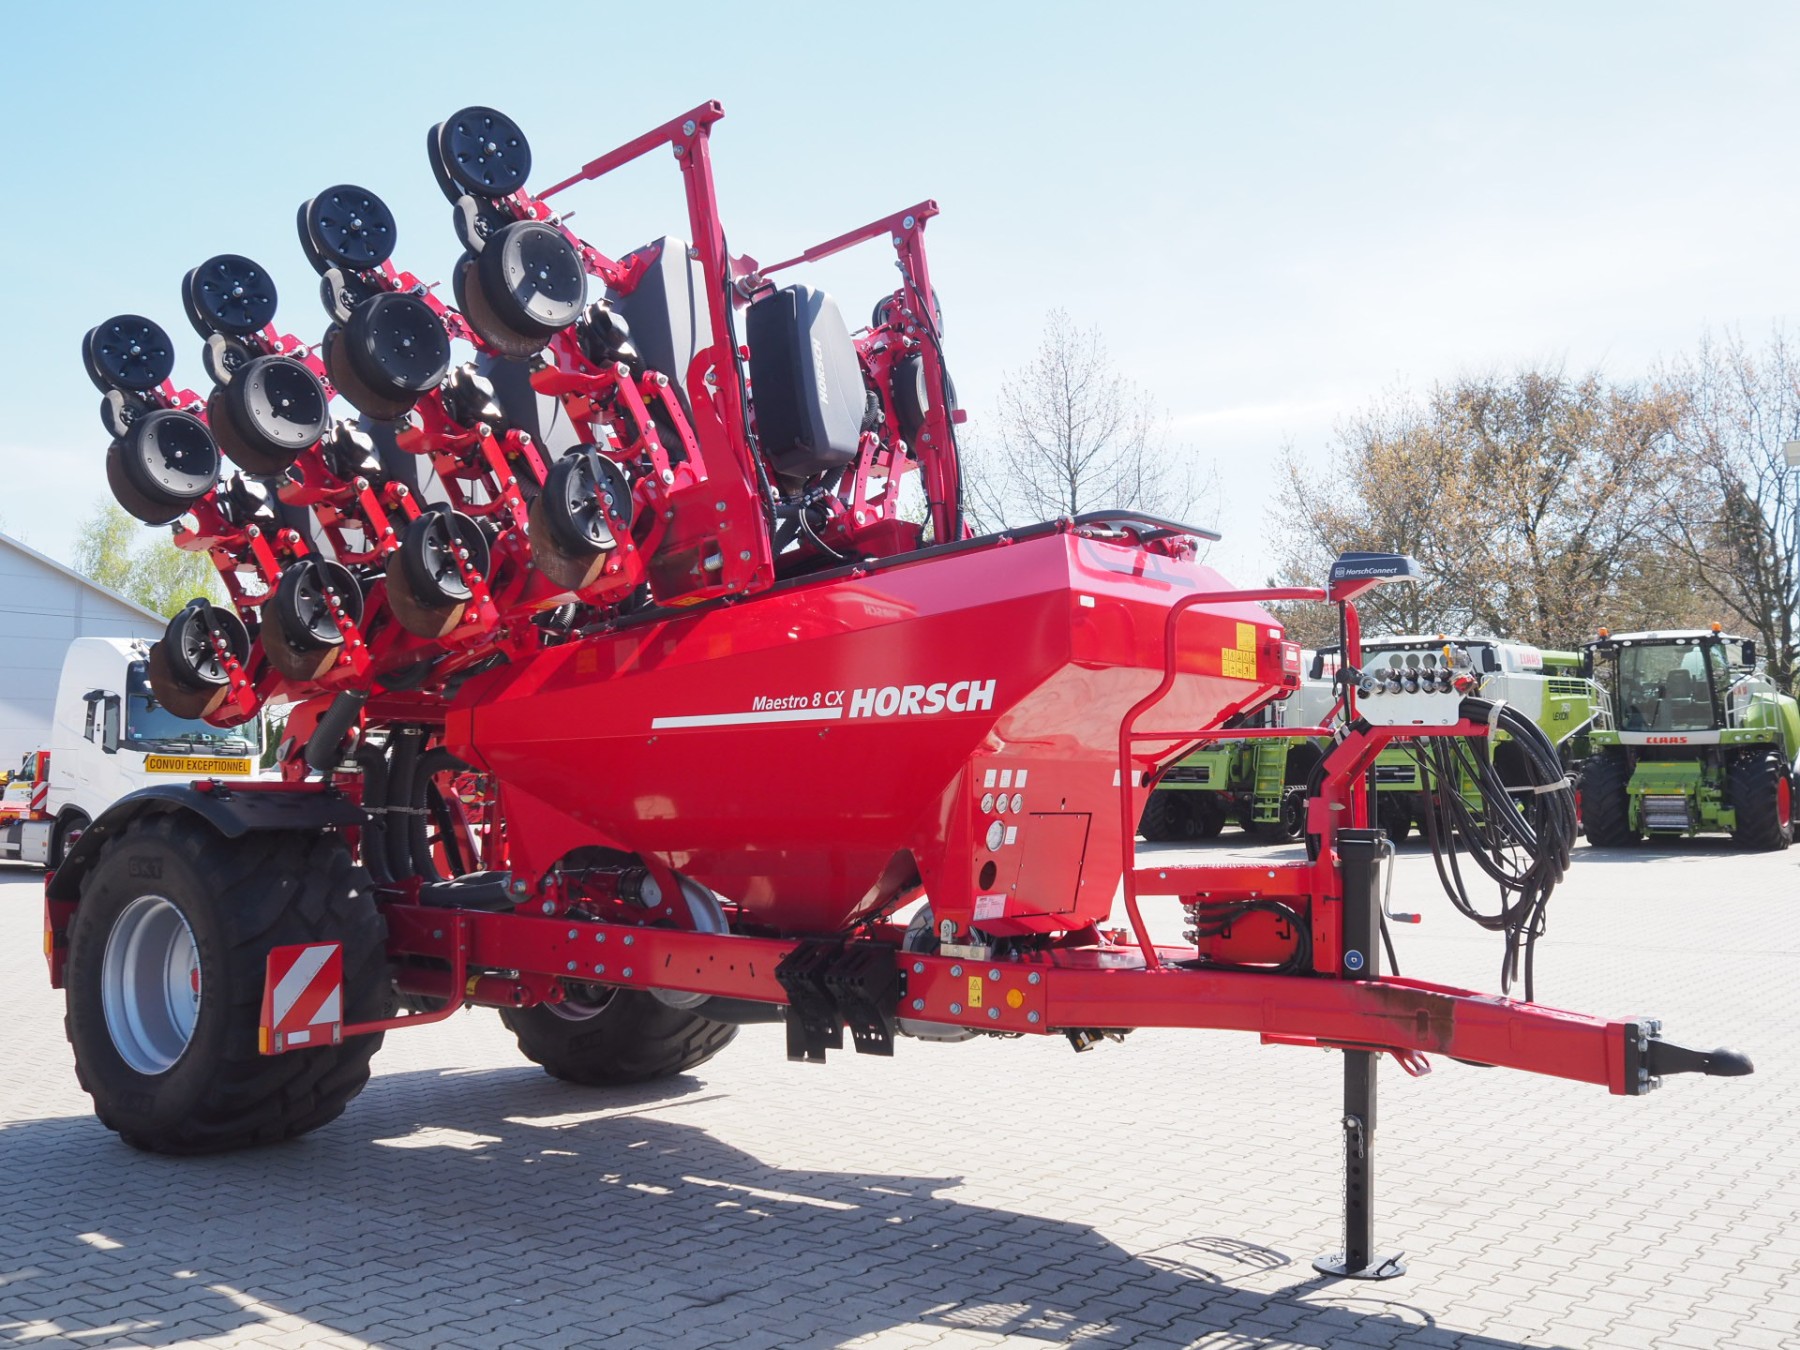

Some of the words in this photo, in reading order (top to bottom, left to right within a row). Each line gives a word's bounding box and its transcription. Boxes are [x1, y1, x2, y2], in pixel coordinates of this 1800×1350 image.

[1345, 567, 1397, 575] HorschConnect
[752, 695, 808, 711] Maestro
[812, 692, 821, 707] 8
[824, 690, 844, 705] CX
[848, 679, 997, 718] HORSCH
[149, 758, 184, 769] CONVOI
[186, 760, 248, 772] EXCEPTIONNEL
